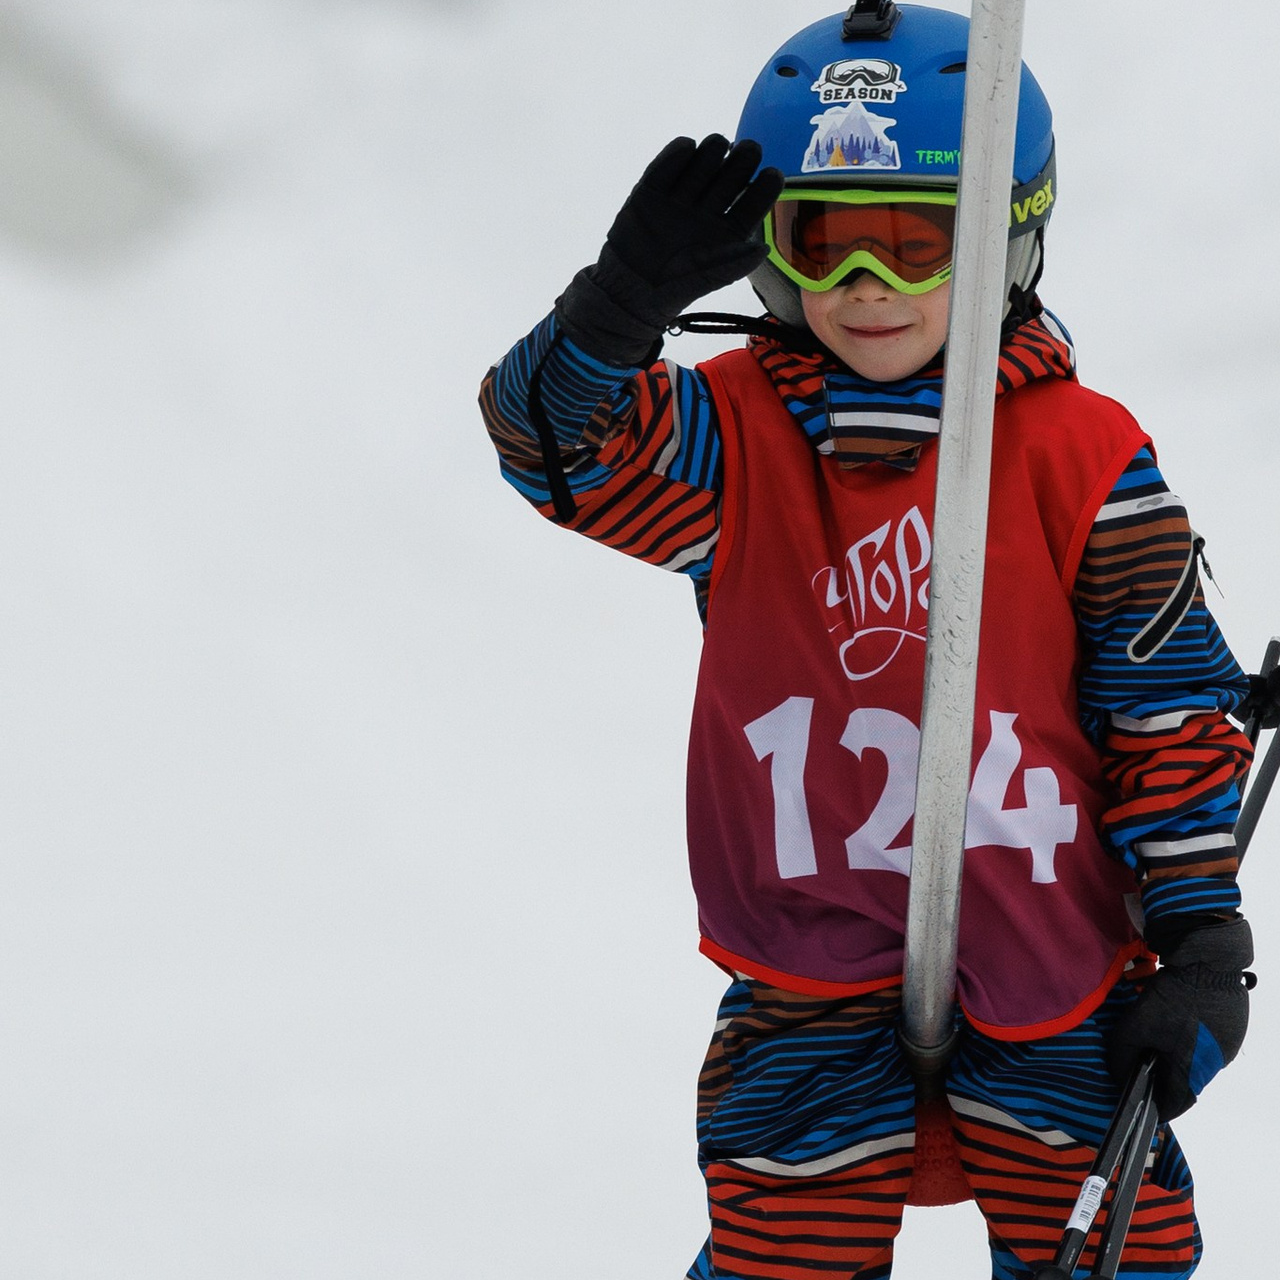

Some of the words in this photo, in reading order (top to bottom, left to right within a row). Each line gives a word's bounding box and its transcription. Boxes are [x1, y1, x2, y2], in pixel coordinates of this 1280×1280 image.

[823, 87, 893, 101] SEASON
[915, 149, 961, 166] TERM'
[743, 696, 1078, 884] 124
